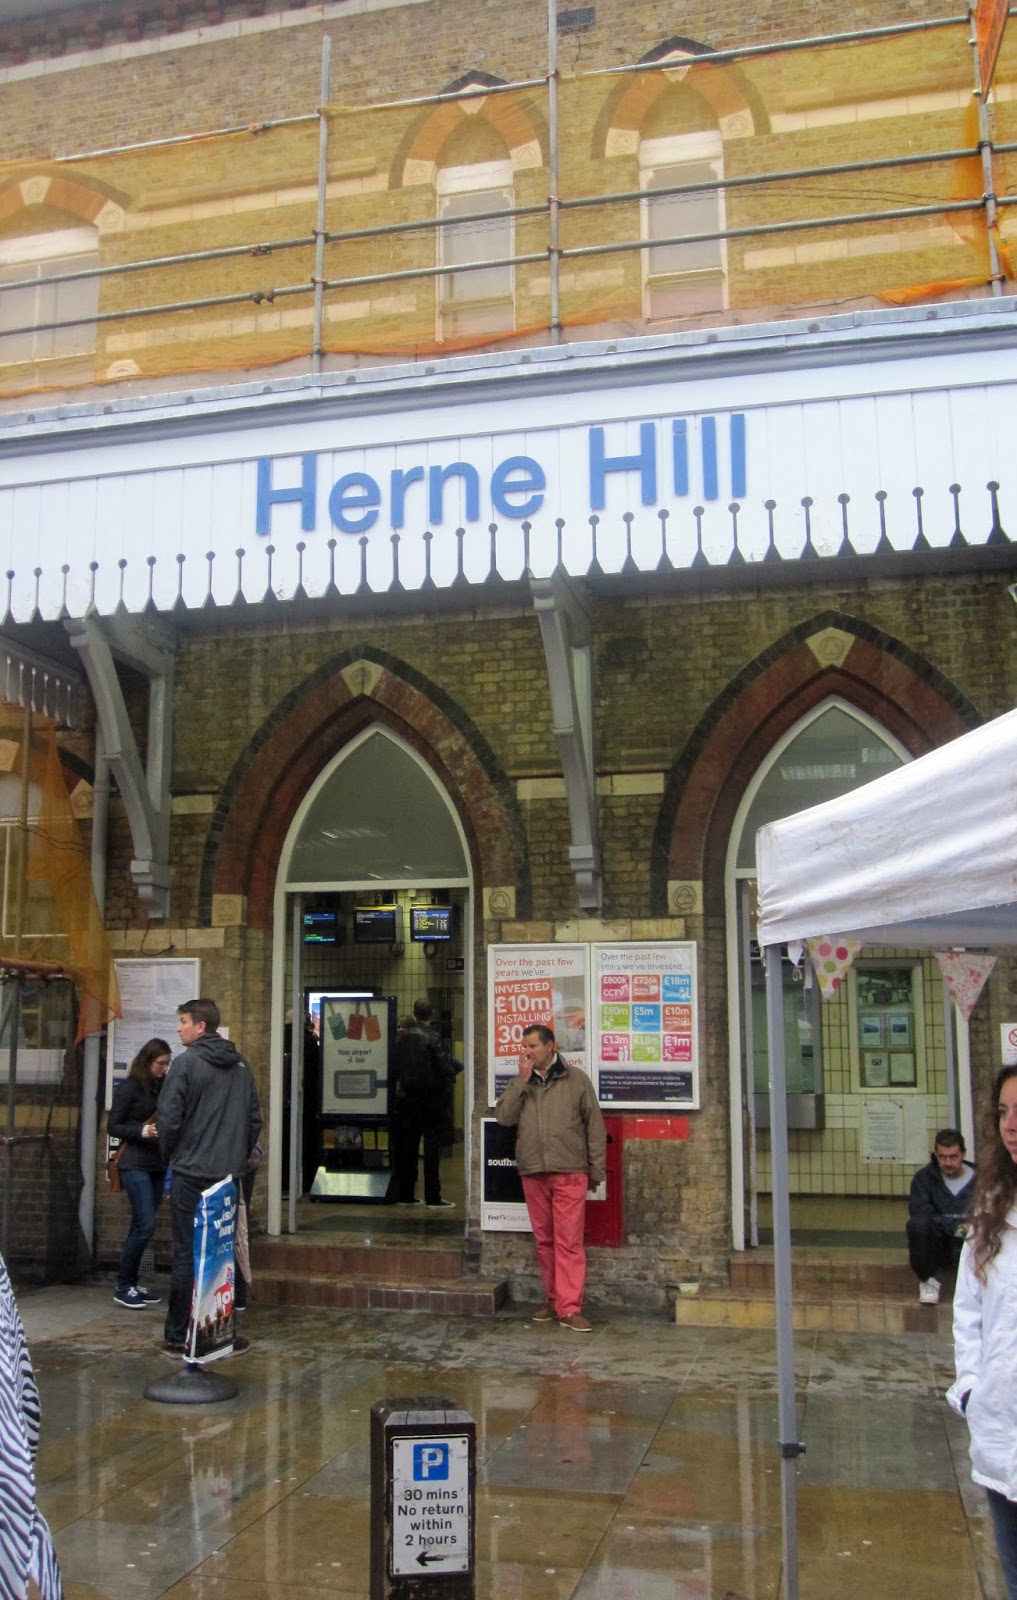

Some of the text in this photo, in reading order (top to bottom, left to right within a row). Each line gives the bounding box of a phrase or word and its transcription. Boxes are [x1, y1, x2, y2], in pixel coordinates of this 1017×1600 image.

[255, 413, 746, 536] Herne Hill
[495, 957, 574, 967] Over the past few
[601, 953, 619, 961] Over
[635, 953, 651, 961] past
[652, 952, 666, 960] few
[495, 969, 520, 978] years
[664, 976, 689, 986] £18m
[495, 982, 550, 994] INVESTED
[602, 988, 624, 997] CCTV
[495, 994, 550, 1014] £10m
[603, 1006, 628, 1015] £80m
[634, 1006, 653, 1016] £5m
[665, 1006, 690, 1016] £10m
[497, 1012, 551, 1024] INSTALLING
[498, 1024, 524, 1044] 30
[603, 1035, 629, 1044] £1.3m
[664, 1035, 690, 1046] £1m
[498, 1045, 510, 1053] AT
[422, 1448, 443, 1478] P
[404, 1488, 458, 1501] 30 mins
[397, 1503, 464, 1517] No return
[410, 1518, 452, 1531] within
[405, 1533, 457, 1546] 2 hours
